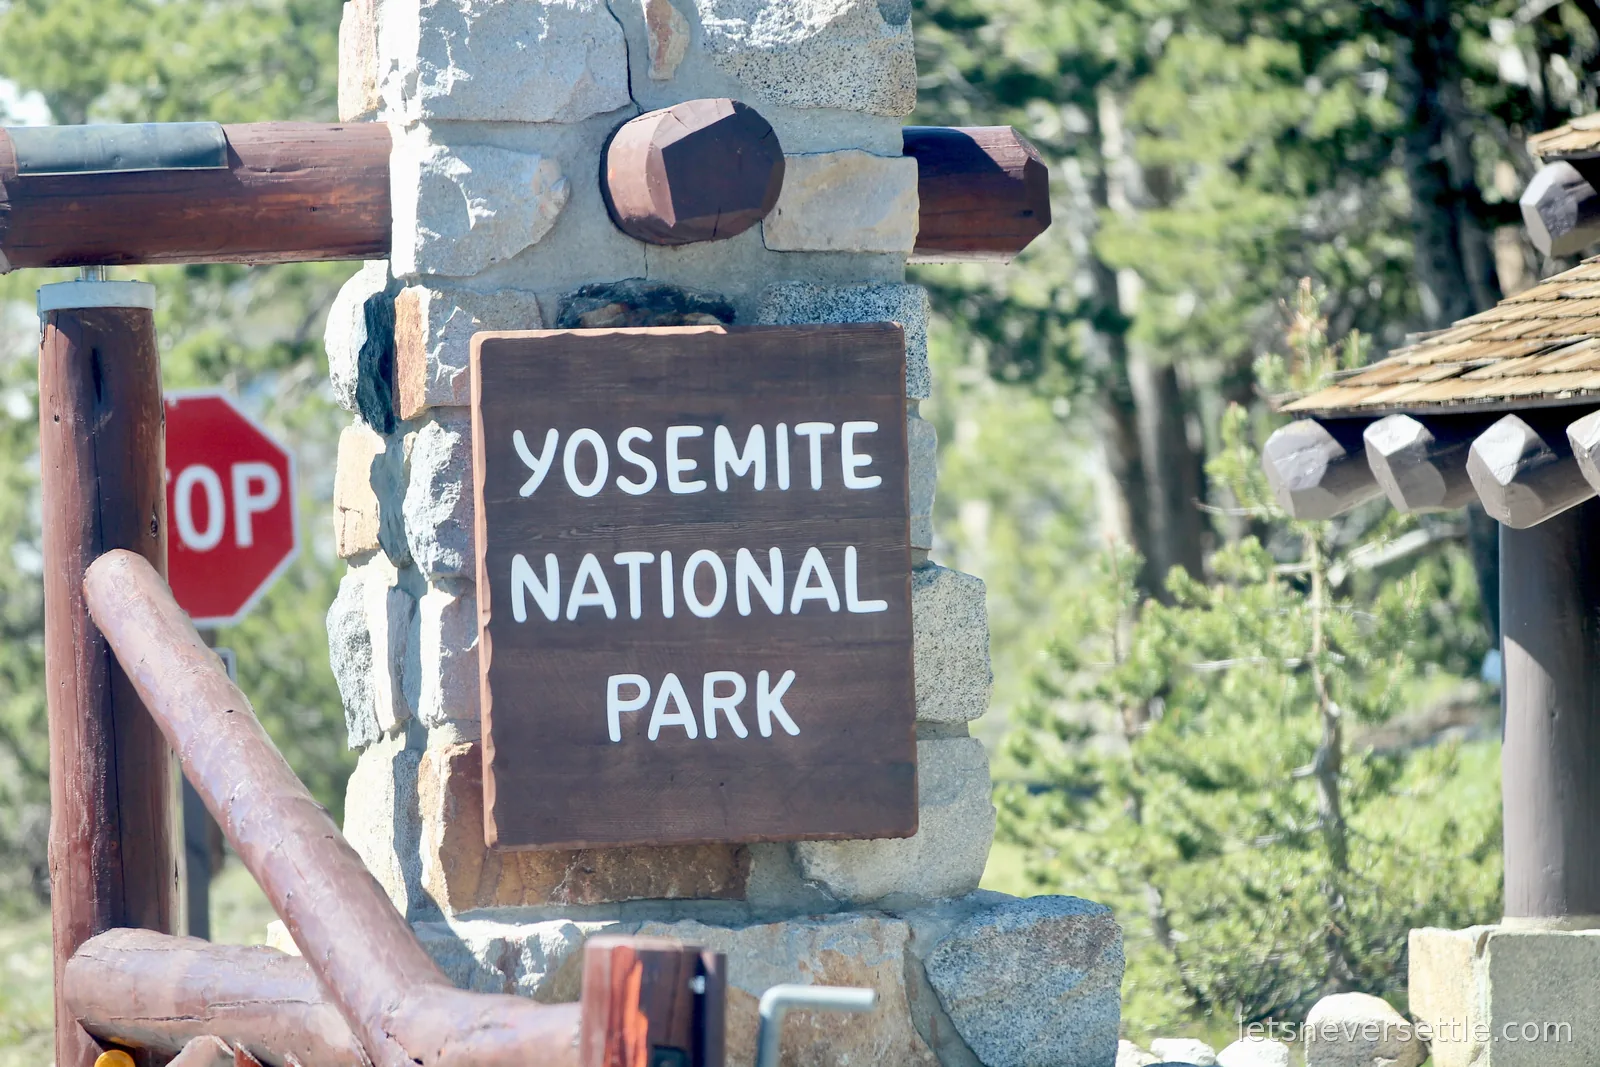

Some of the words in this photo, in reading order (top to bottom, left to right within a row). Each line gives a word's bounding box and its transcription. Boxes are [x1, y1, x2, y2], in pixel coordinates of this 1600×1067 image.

[512, 420, 883, 498] YOSEMITE
[166, 462, 281, 552] OP
[510, 545, 889, 623] NATIONAL
[606, 669, 801, 743] PARK
